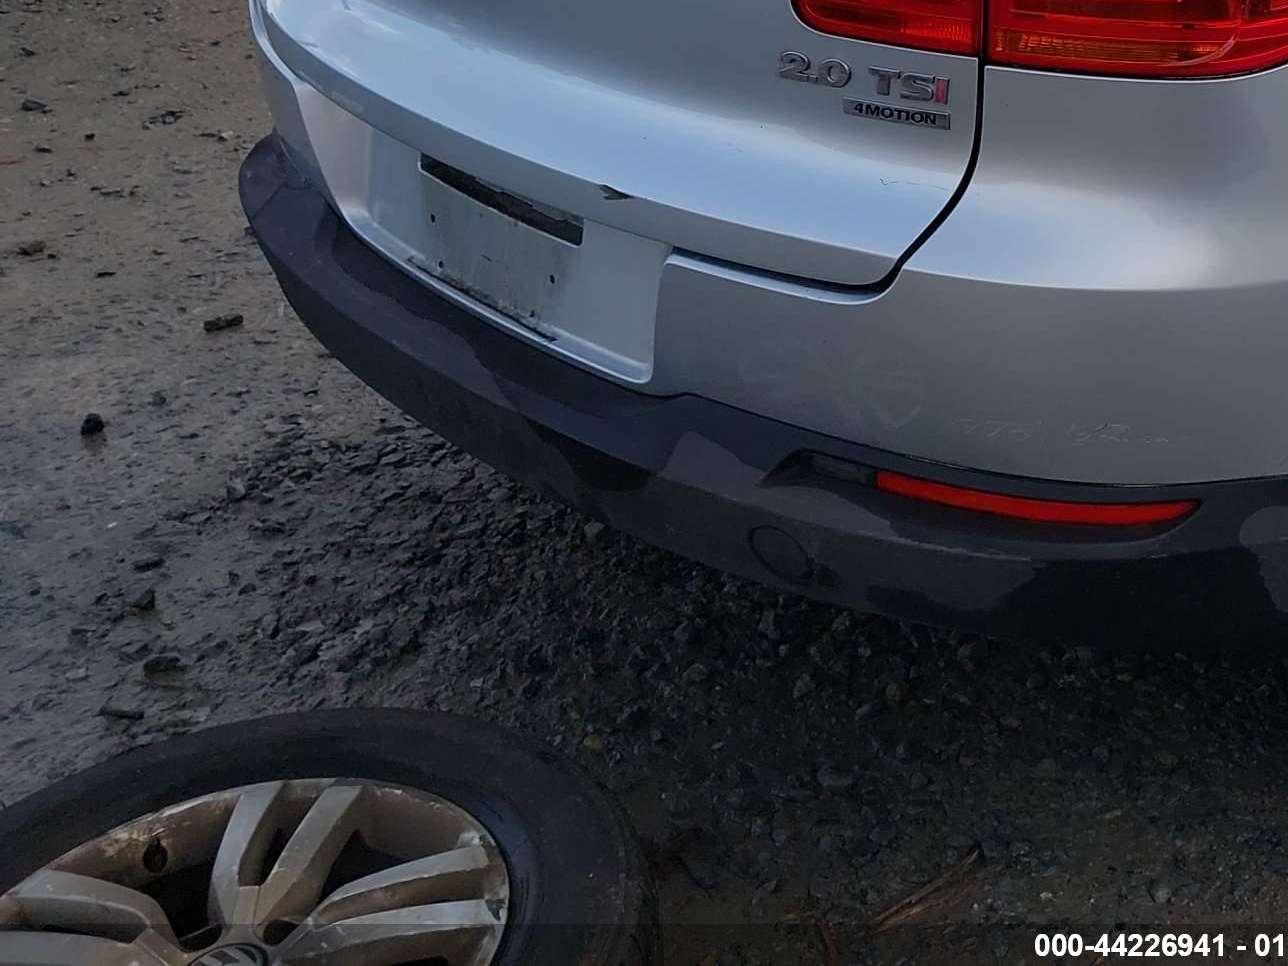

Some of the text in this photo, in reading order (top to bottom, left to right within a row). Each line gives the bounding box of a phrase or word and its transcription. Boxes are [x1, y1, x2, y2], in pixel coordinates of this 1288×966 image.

[778, 51, 950, 105] 2.0 TSI
[853, 103, 937, 126] 4MOTION
